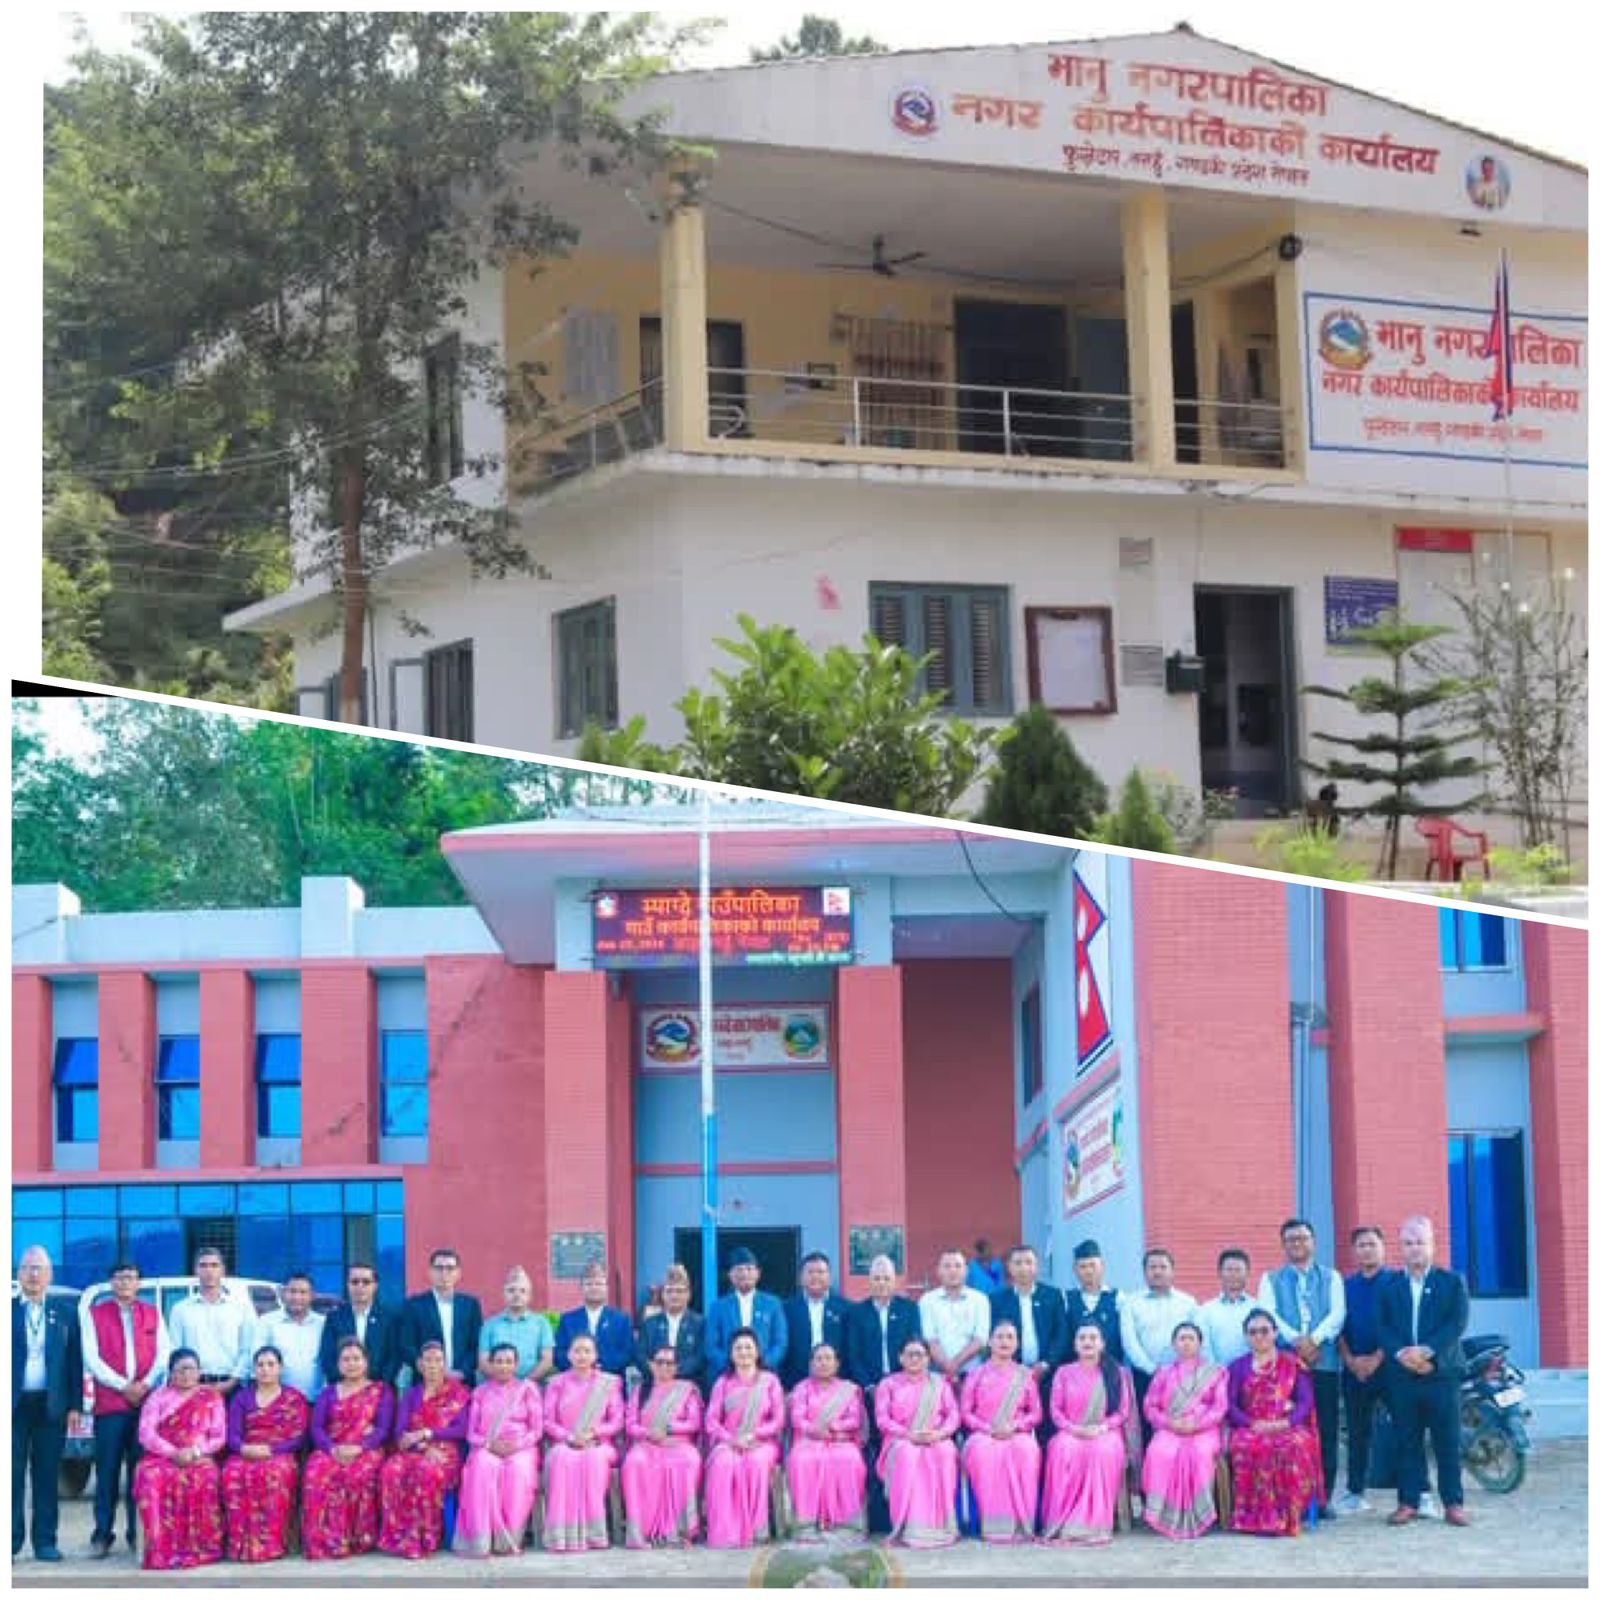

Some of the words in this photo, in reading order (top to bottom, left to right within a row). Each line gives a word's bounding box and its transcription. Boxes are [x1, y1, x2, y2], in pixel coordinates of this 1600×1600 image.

[1047, 54, 1109, 102] भानु
[1126, 61, 1329, 116] नगरपालिका
[951, 93, 1042, 129] नगर
[1319, 131, 1440, 175] कार्यालय
[1375, 319, 1425, 365] भानु
